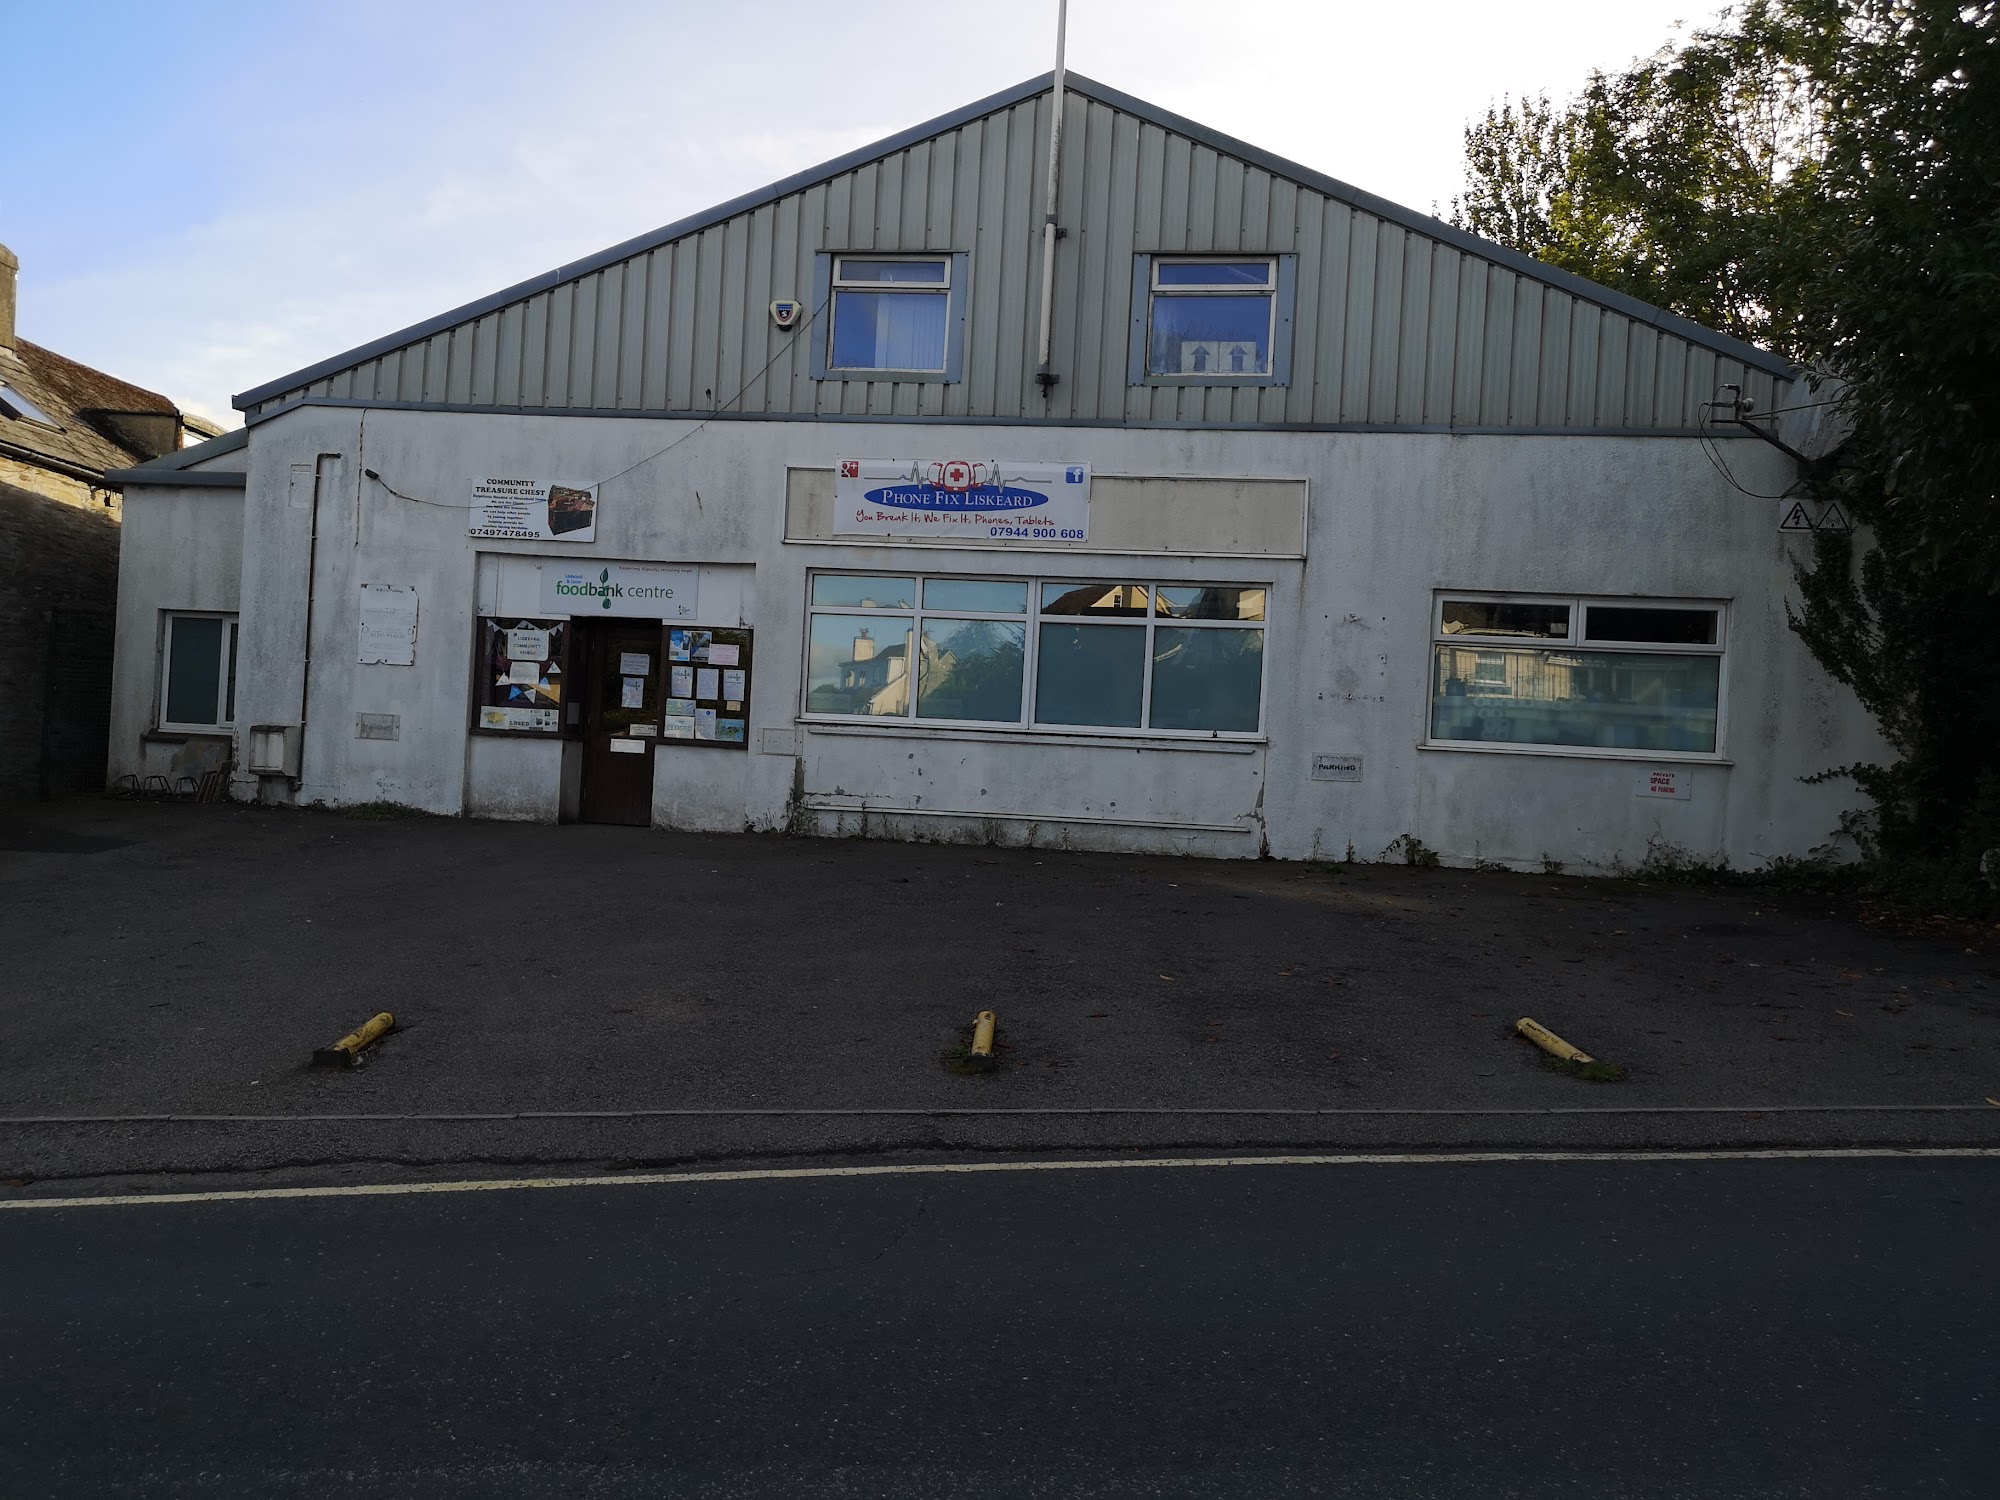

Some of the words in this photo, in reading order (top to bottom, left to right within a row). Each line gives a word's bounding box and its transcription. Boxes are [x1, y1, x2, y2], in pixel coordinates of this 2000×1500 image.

[486, 478, 536, 487] COMMUNITY
[476, 486, 518, 494] TREASURE
[882, 490, 930, 504] PHONE
[934, 490, 960, 505] FIX
[964, 491, 1033, 507] LISKEARD
[856, 509, 874, 522] You
[876, 512, 908, 522] Break
[924, 512, 940, 523] We
[942, 513, 958, 523] Fix
[975, 514, 1012, 525] Phones,
[1014, 515, 1055, 526] Tablets
[470, 528, 540, 538] 07497478495
[990, 527, 1029, 537] 07944
[1033, 528, 1056, 538] 900
[1060, 529, 1084, 539] 608
[556, 580, 624, 597] foodbank
[628, 586, 674, 598] centre
